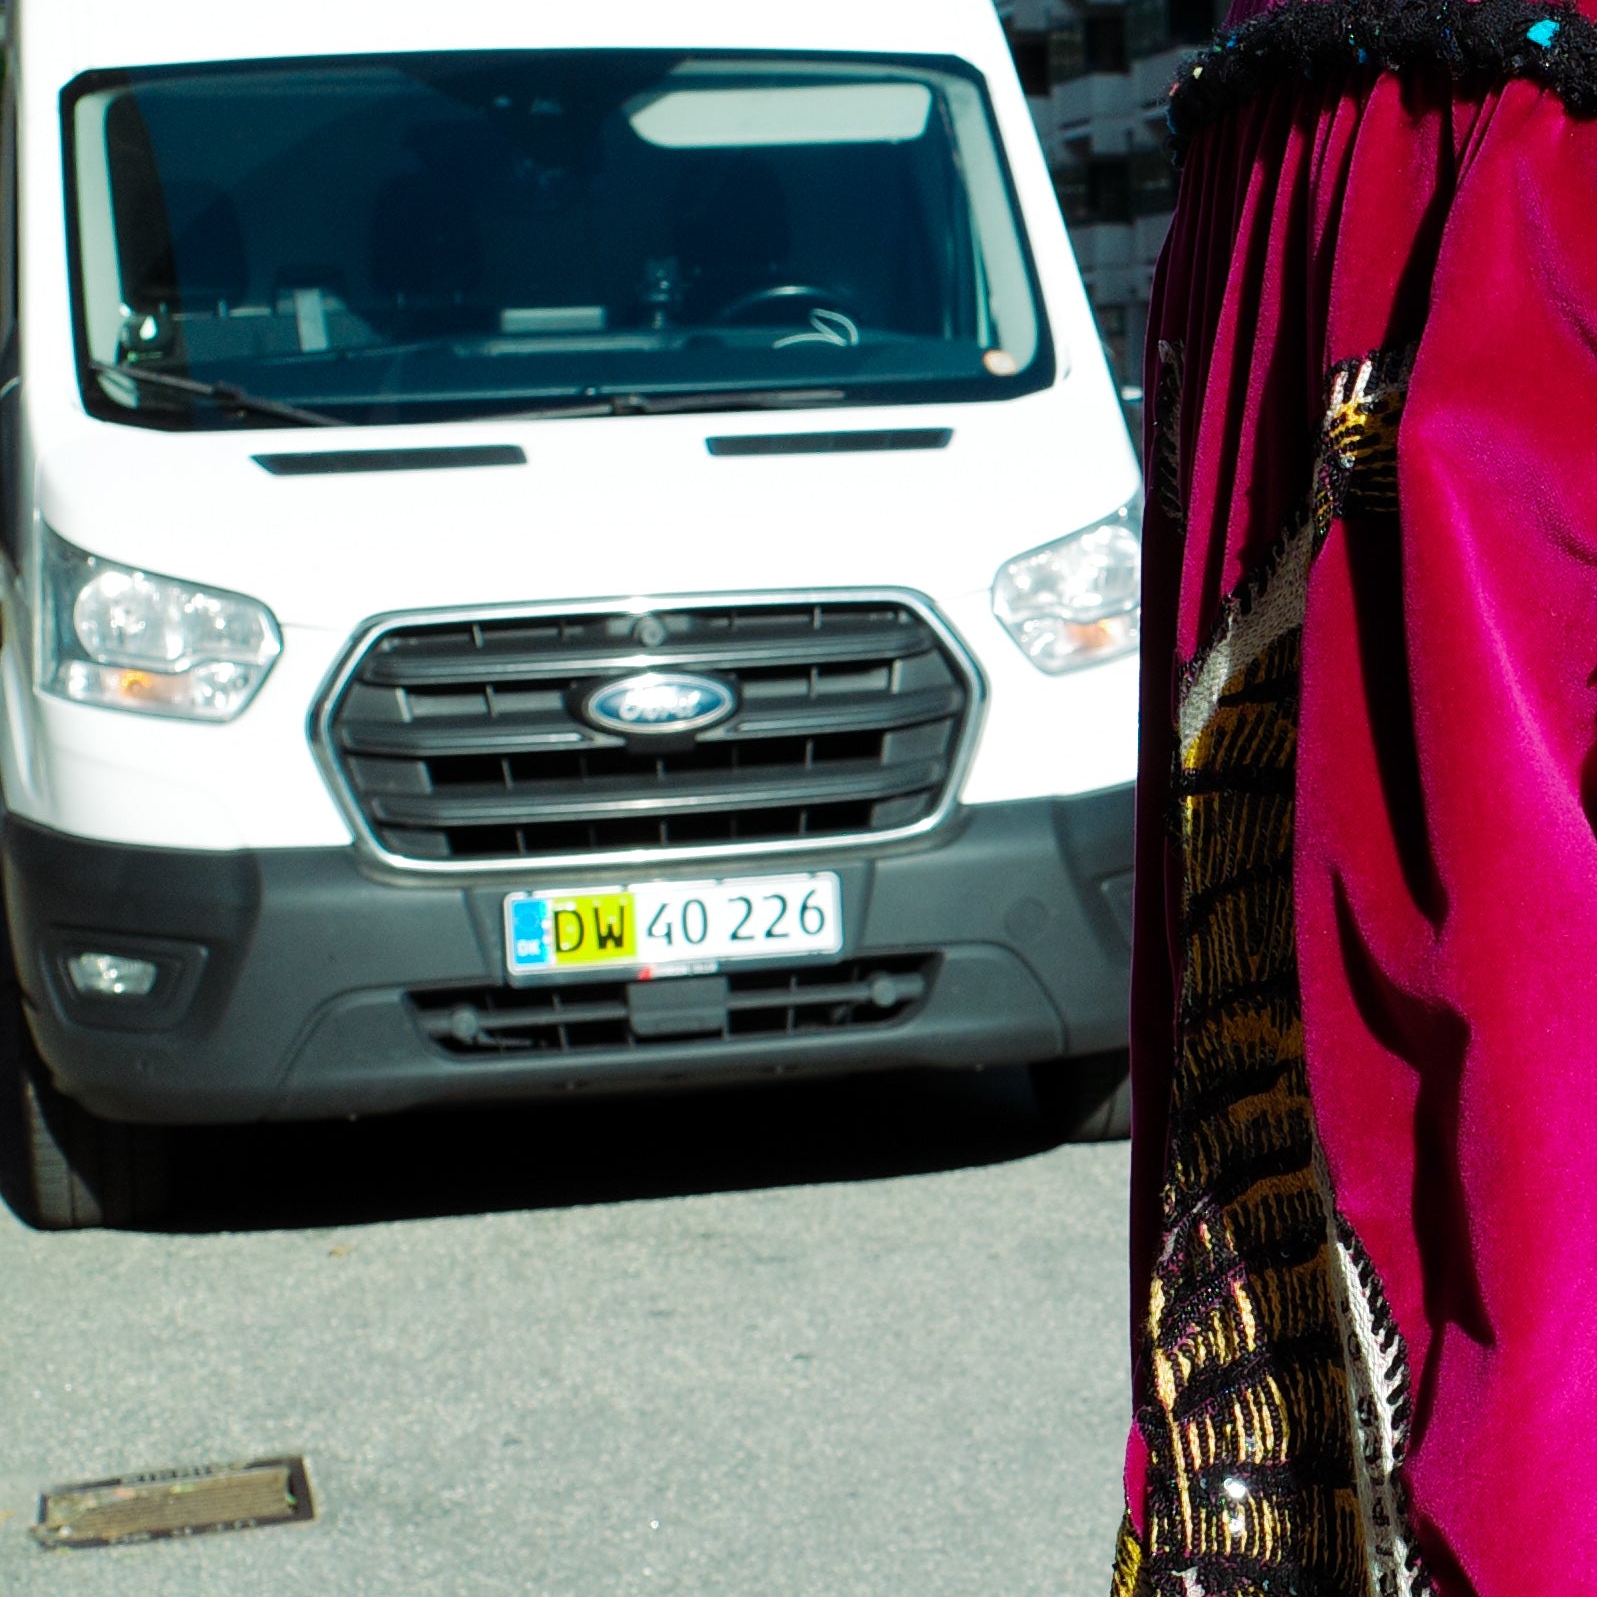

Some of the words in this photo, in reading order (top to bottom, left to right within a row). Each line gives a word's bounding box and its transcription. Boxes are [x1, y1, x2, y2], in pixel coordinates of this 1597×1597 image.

[552, 904, 626, 953] DW
[646, 899, 708, 946] 40
[728, 888, 826, 941] 226
